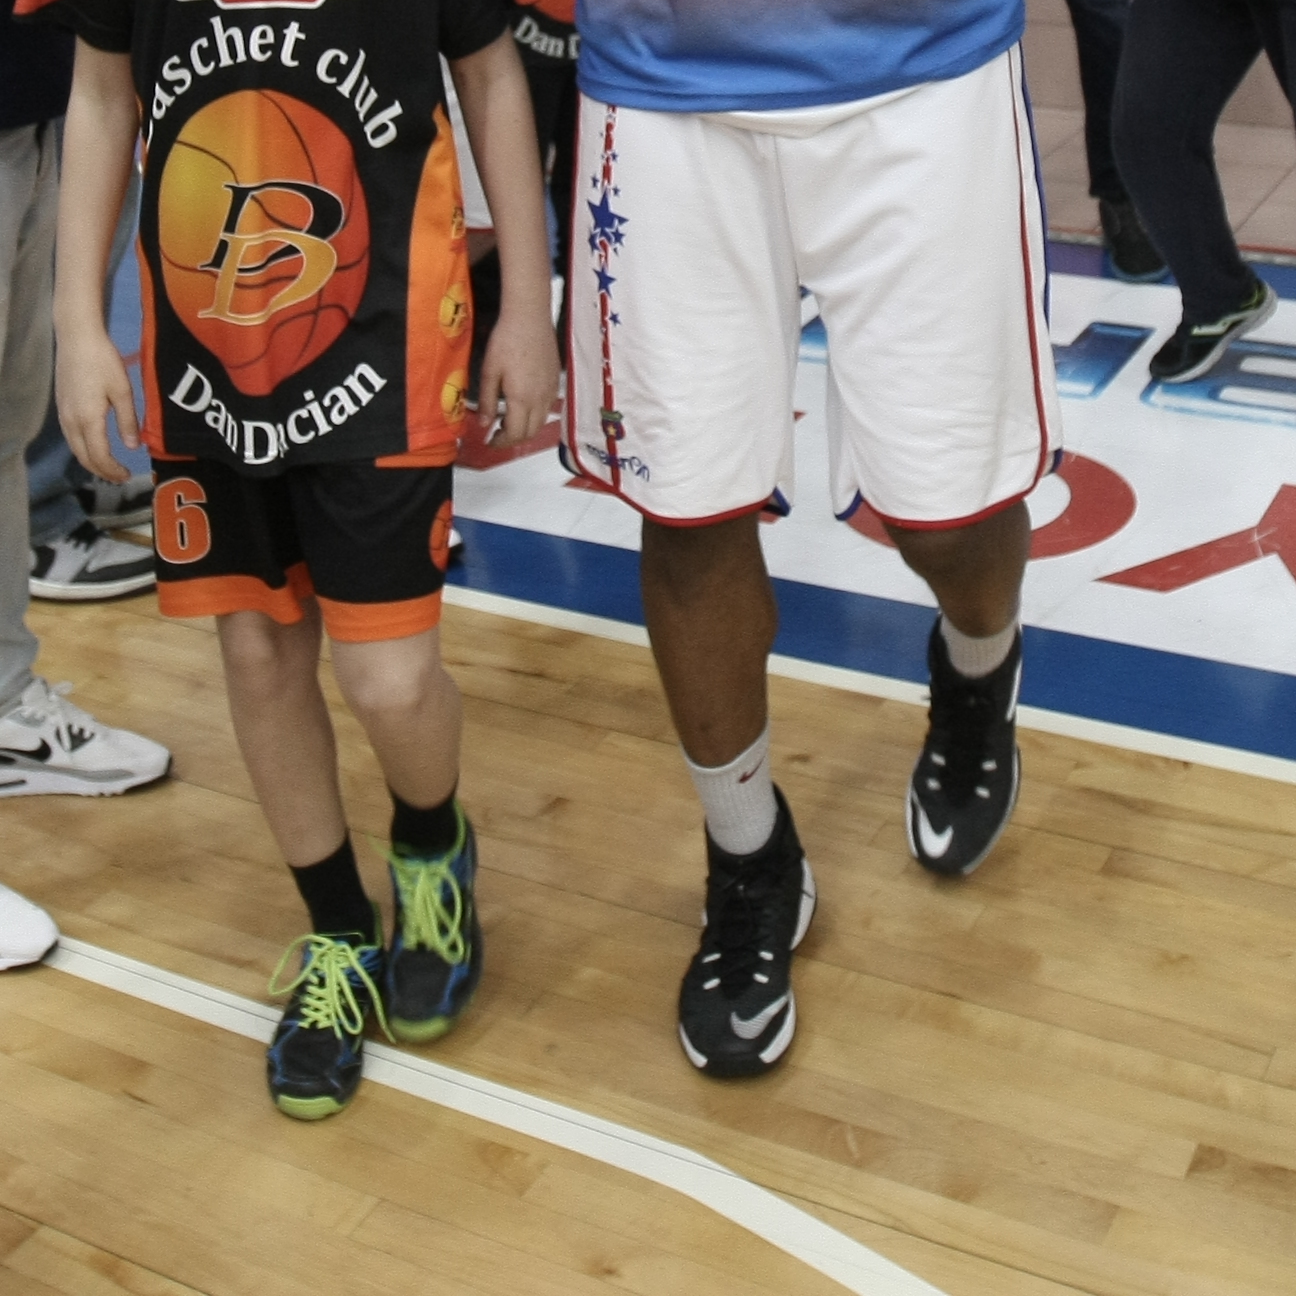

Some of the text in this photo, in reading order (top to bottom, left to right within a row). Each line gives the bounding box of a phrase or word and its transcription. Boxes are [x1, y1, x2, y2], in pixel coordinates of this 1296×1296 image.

[146, 15, 404, 152] aschet club
[168, 362, 239, 454] Dan
[153, 477, 212, 564] 6
